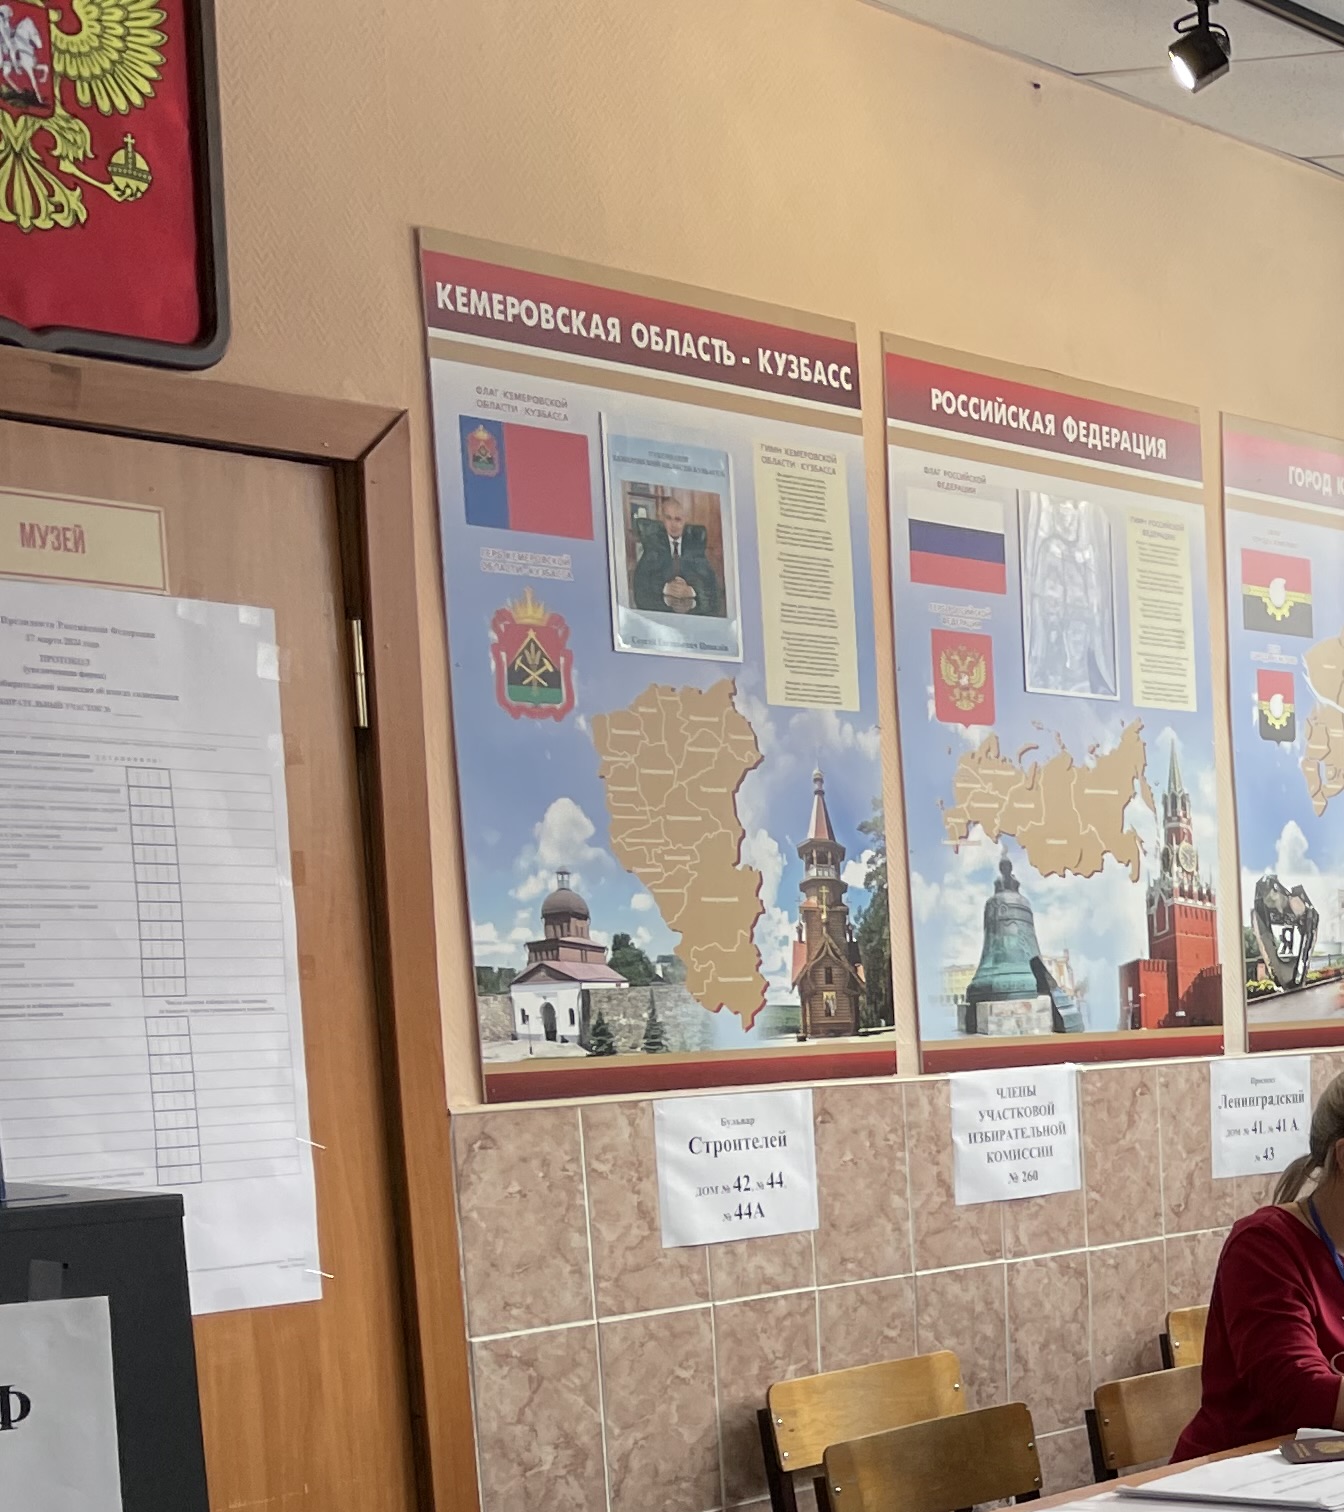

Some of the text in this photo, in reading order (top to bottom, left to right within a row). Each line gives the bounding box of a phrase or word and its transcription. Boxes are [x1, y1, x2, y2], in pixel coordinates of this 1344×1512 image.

[435, 281, 622, 344] КЕМЕРОВСКАЯ
[631, 322, 736, 367] ОБЛАСТЬ
[757, 348, 853, 391] КУЗБАСС
[930, 388, 1167, 460] РОССИЙСКАЯ ФЕДЕРАЦИЯ
[1288, 466, 1332, 497] ГОРОД
[19, 521, 87, 555] МУЗЕЙ
[996, 1085, 1037, 1099] ЧЛЕНЫ
[1218, 1090, 1305, 1110] Ленинградский
[978, 1101, 1055, 1122] УЧАСТКОВОЙ
[968, 1121, 1066, 1144] ИЗБИРАТЕЛЬНОЙ
[688, 1130, 787, 1158] Строителей
[986, 1145, 1053, 1164] КОМИССИИ
[1262, 1147, 1275, 1161] 43
[1008, 1170, 1039, 1184] № 260
